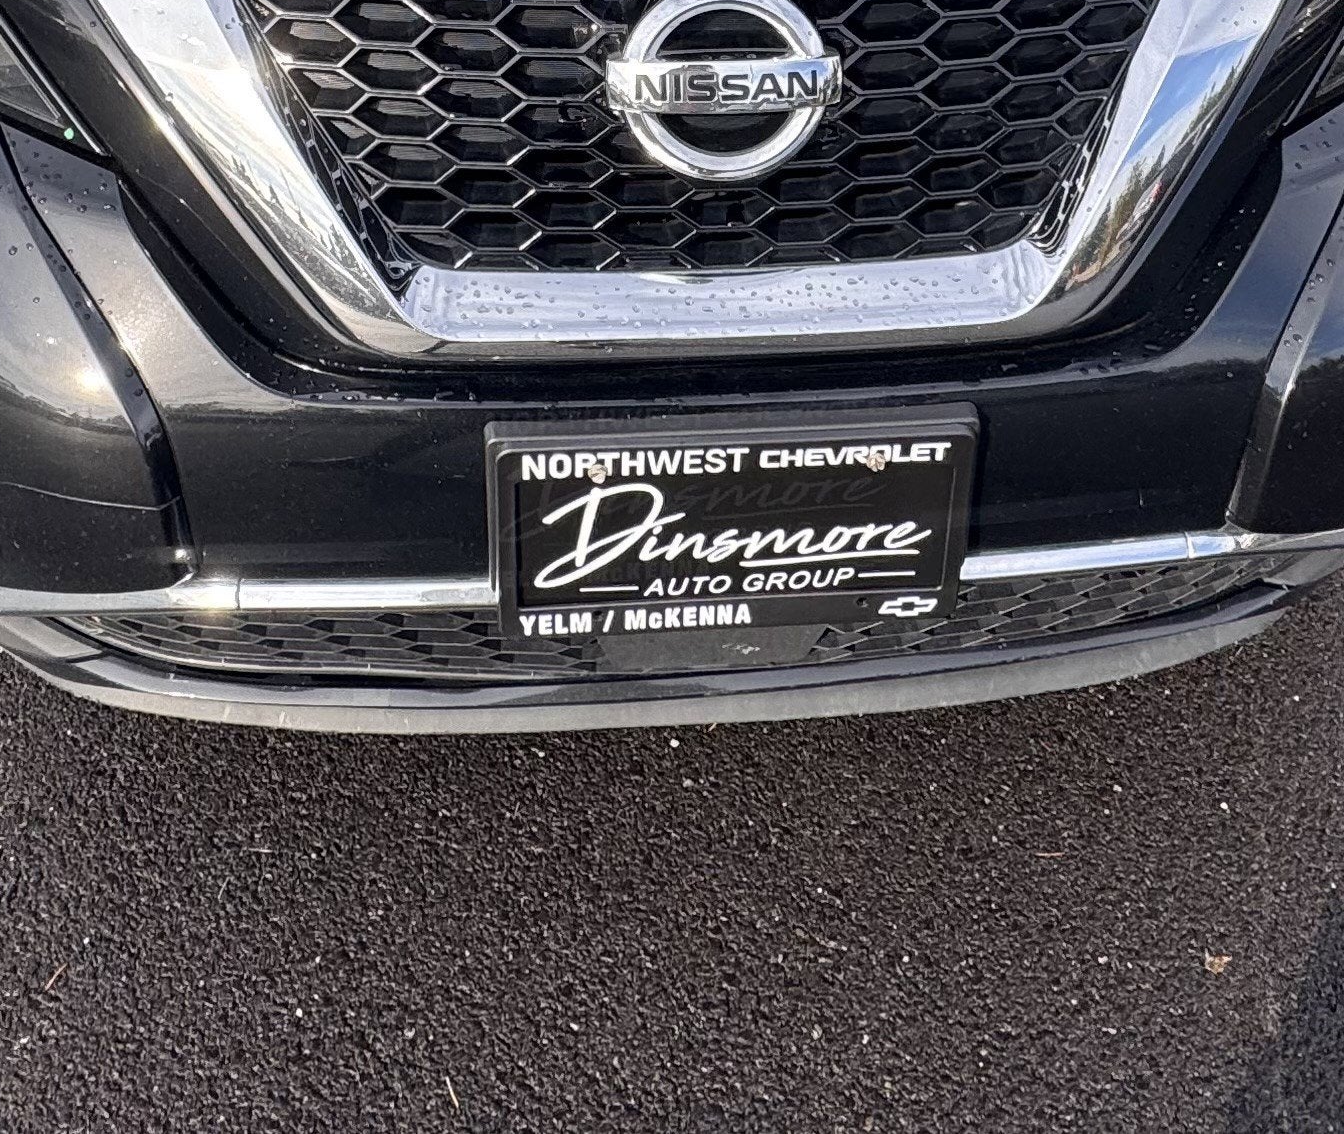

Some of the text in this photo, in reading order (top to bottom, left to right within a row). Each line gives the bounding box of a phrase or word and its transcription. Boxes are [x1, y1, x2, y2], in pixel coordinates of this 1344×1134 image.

[634, 69, 819, 104] NISSAN
[521, 442, 952, 481] NORTHWEST CHEVROLET
[534, 483, 932, 589] Dinsmore
[643, 567, 856, 598] AUTO GROUP
[519, 611, 593, 637] YELM
[624, 604, 752, 632] McKENNA
